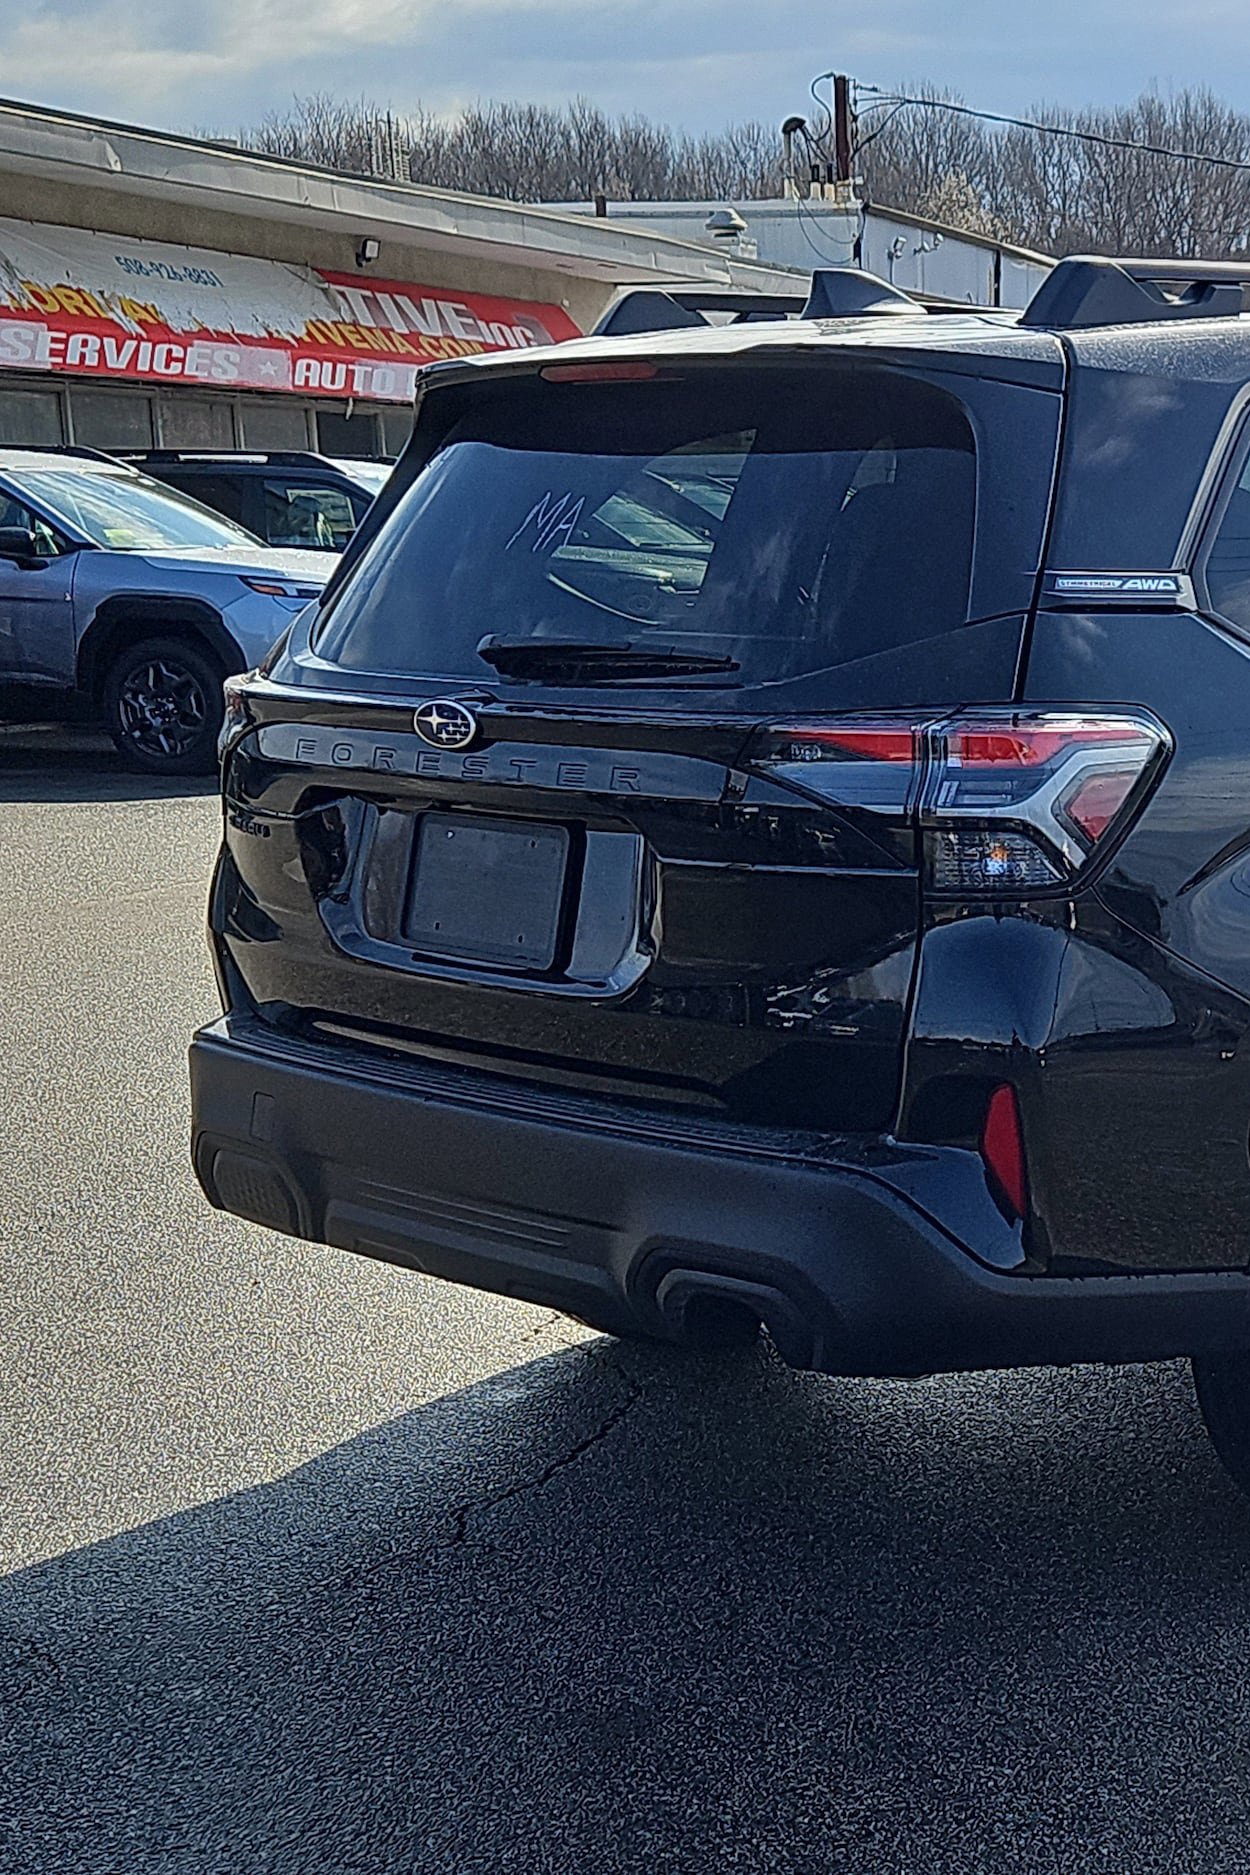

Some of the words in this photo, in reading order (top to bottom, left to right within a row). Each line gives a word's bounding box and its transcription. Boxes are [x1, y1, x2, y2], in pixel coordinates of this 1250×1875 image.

[114, 254, 225, 288] 508-926-8831
[0, 326, 241, 380] SERVICES
[293, 358, 395, 398] AUTO
[1121, 578, 1178, 591] AWD
[294, 737, 643, 792] FORESTER
